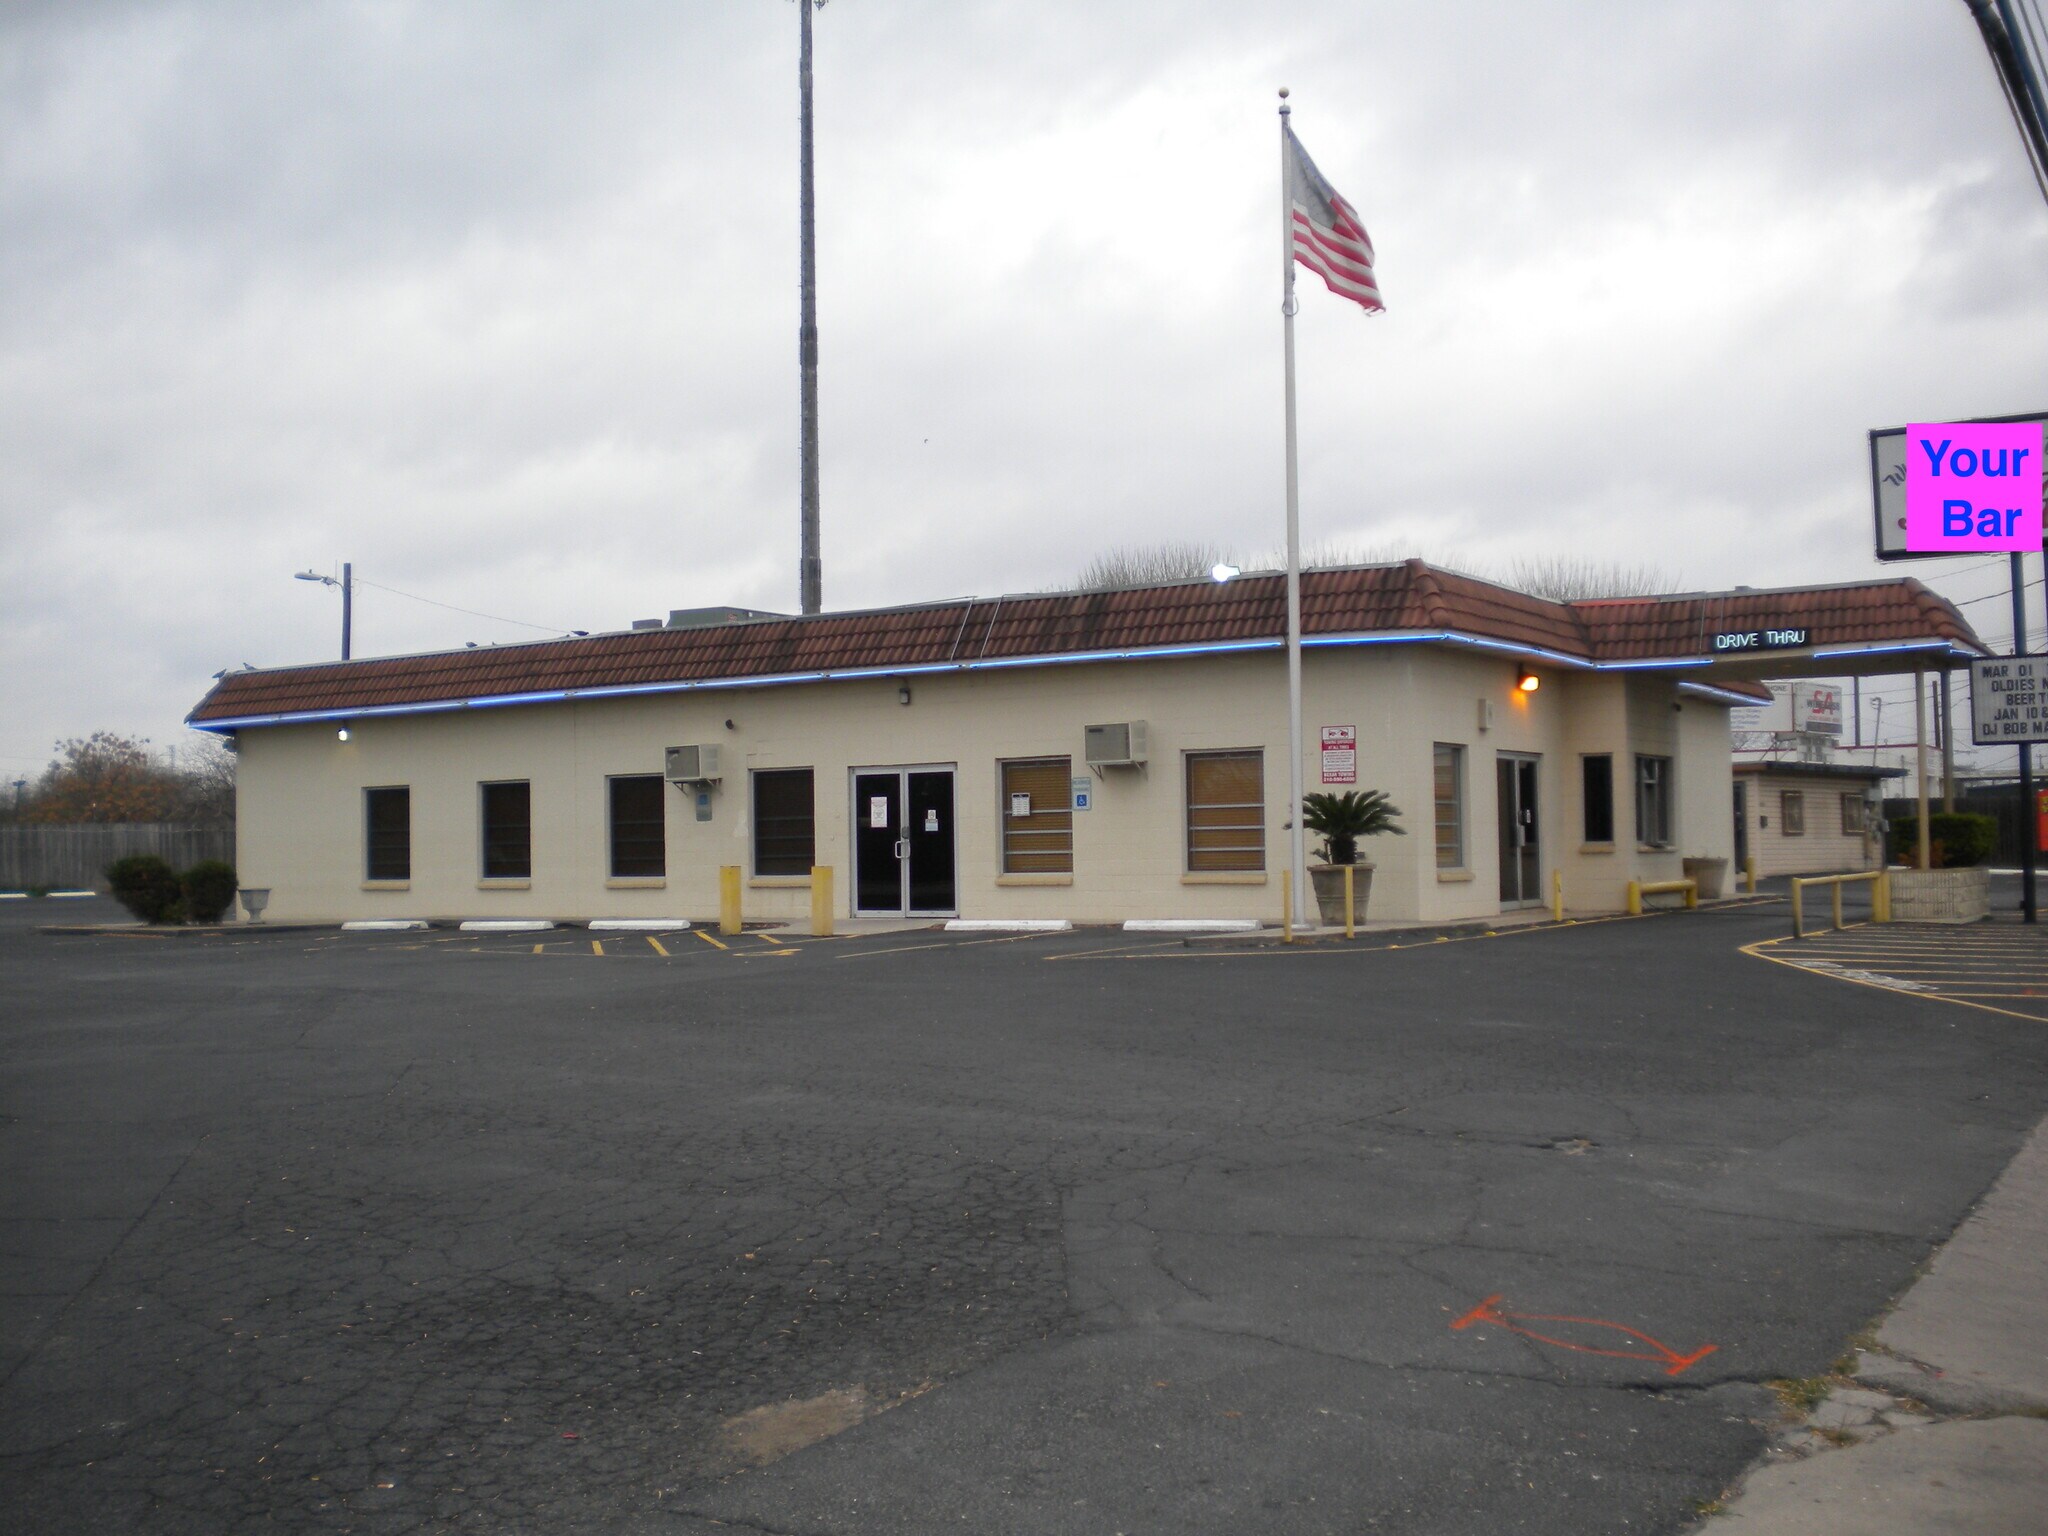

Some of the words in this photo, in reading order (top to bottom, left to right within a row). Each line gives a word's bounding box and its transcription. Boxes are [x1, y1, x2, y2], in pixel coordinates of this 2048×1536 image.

[1717, 633, 1758, 649] DRIVE
[1767, 630, 1805, 644] THRU
[1982, 666, 2008, 678] MAR
[1992, 680, 2034, 692] OLDIES
[2006, 693, 2035, 706] BEER
[1994, 708, 2018, 720] JAN
[2004, 722, 2028, 734] BOB
